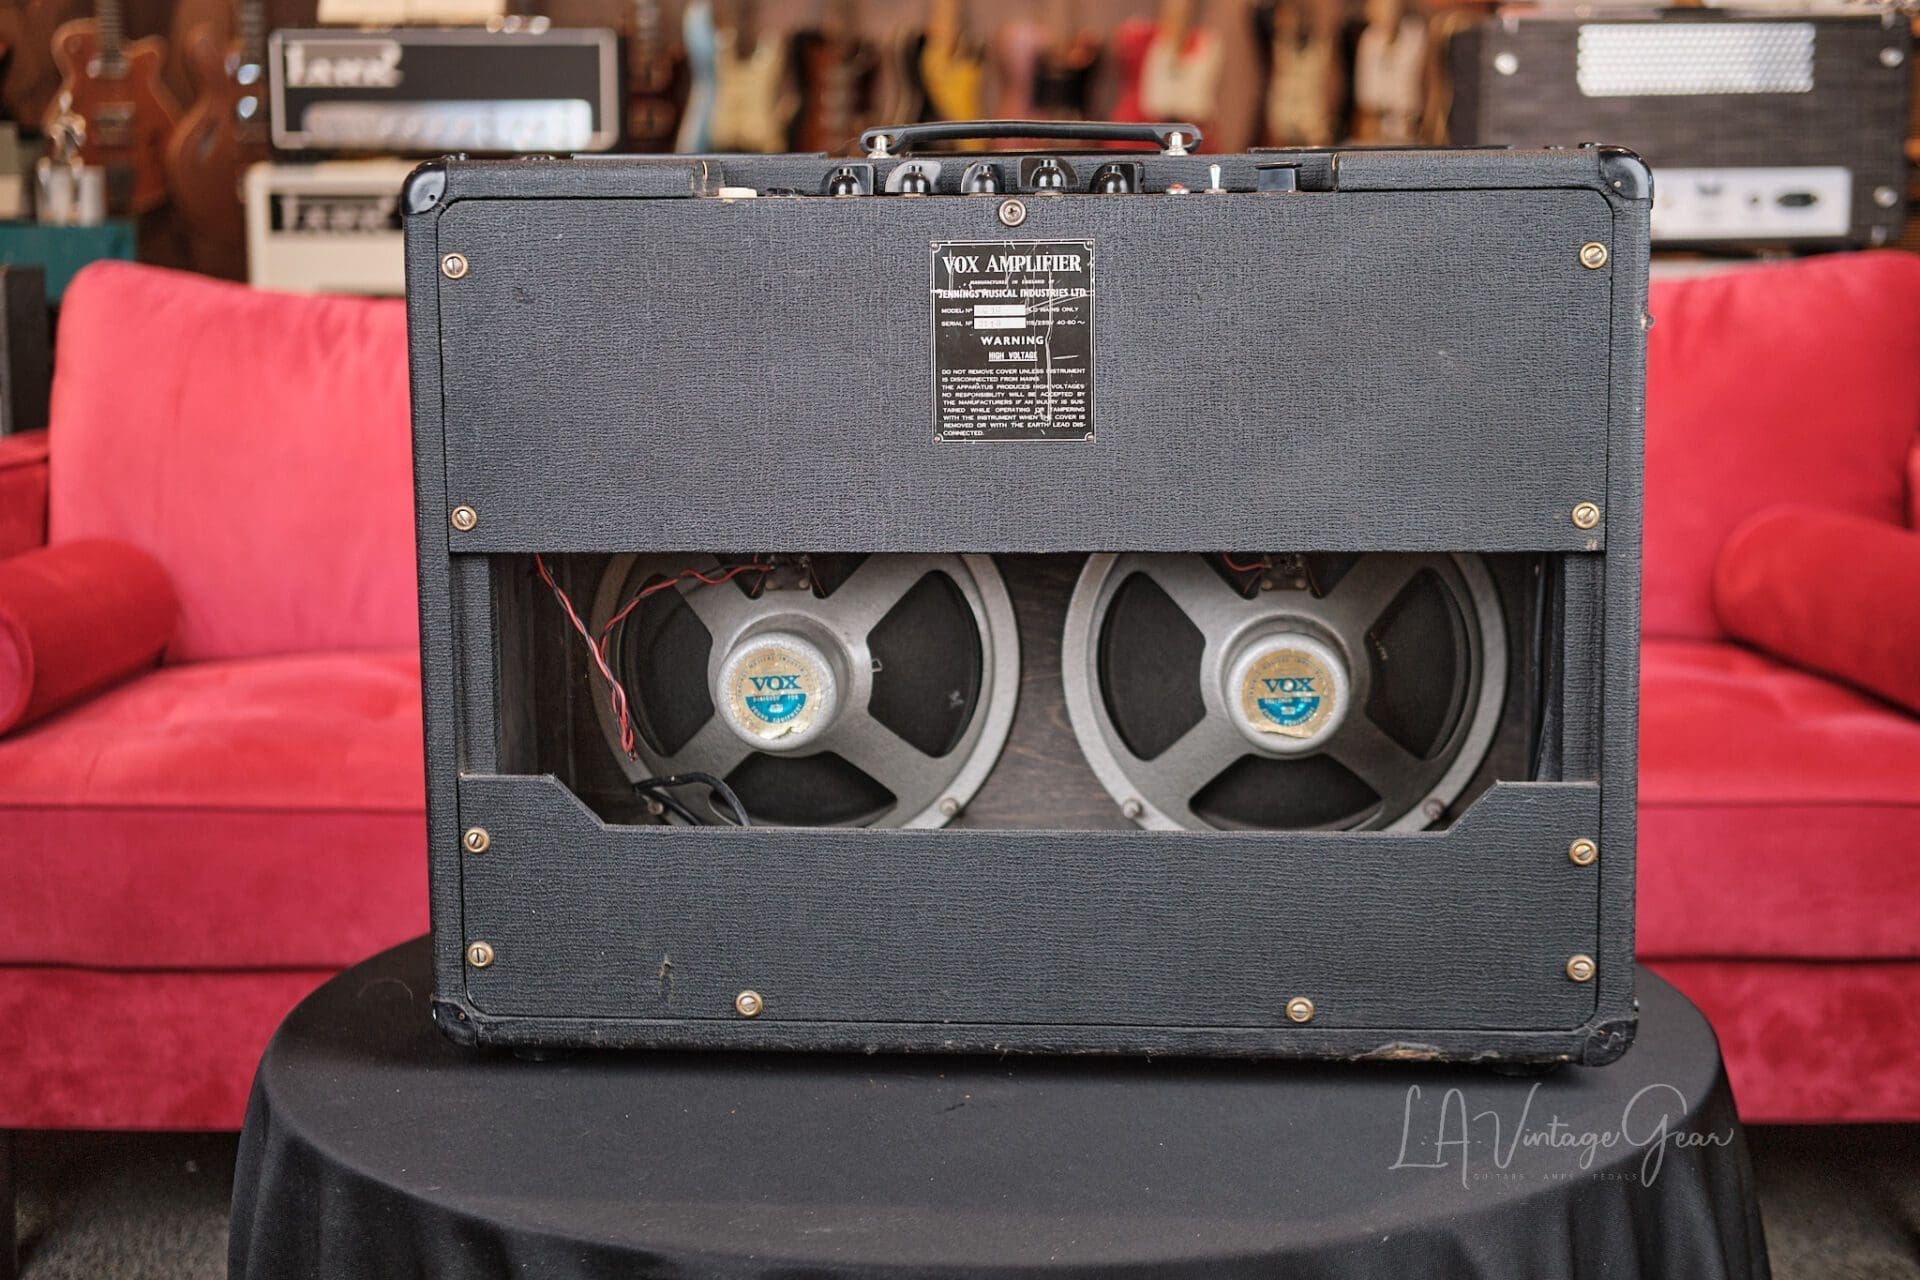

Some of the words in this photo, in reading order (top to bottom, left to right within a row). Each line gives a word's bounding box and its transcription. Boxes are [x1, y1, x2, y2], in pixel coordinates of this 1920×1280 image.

[942, 255, 979, 274] VOX
[985, 254, 1082, 273] AMPLIFIER
[938, 288, 979, 299] JENNINGS
[980, 288, 1018, 298] MUSICAL
[1020, 287, 1069, 298] INDUSTRIES
[980, 335, 1044, 346] WARNING
[988, 351, 1004, 360] HIGH
[1008, 351, 1037, 360] VOLTAGE
[748, 674, 802, 691] VOX
[1261, 677, 1316, 693] VOX
